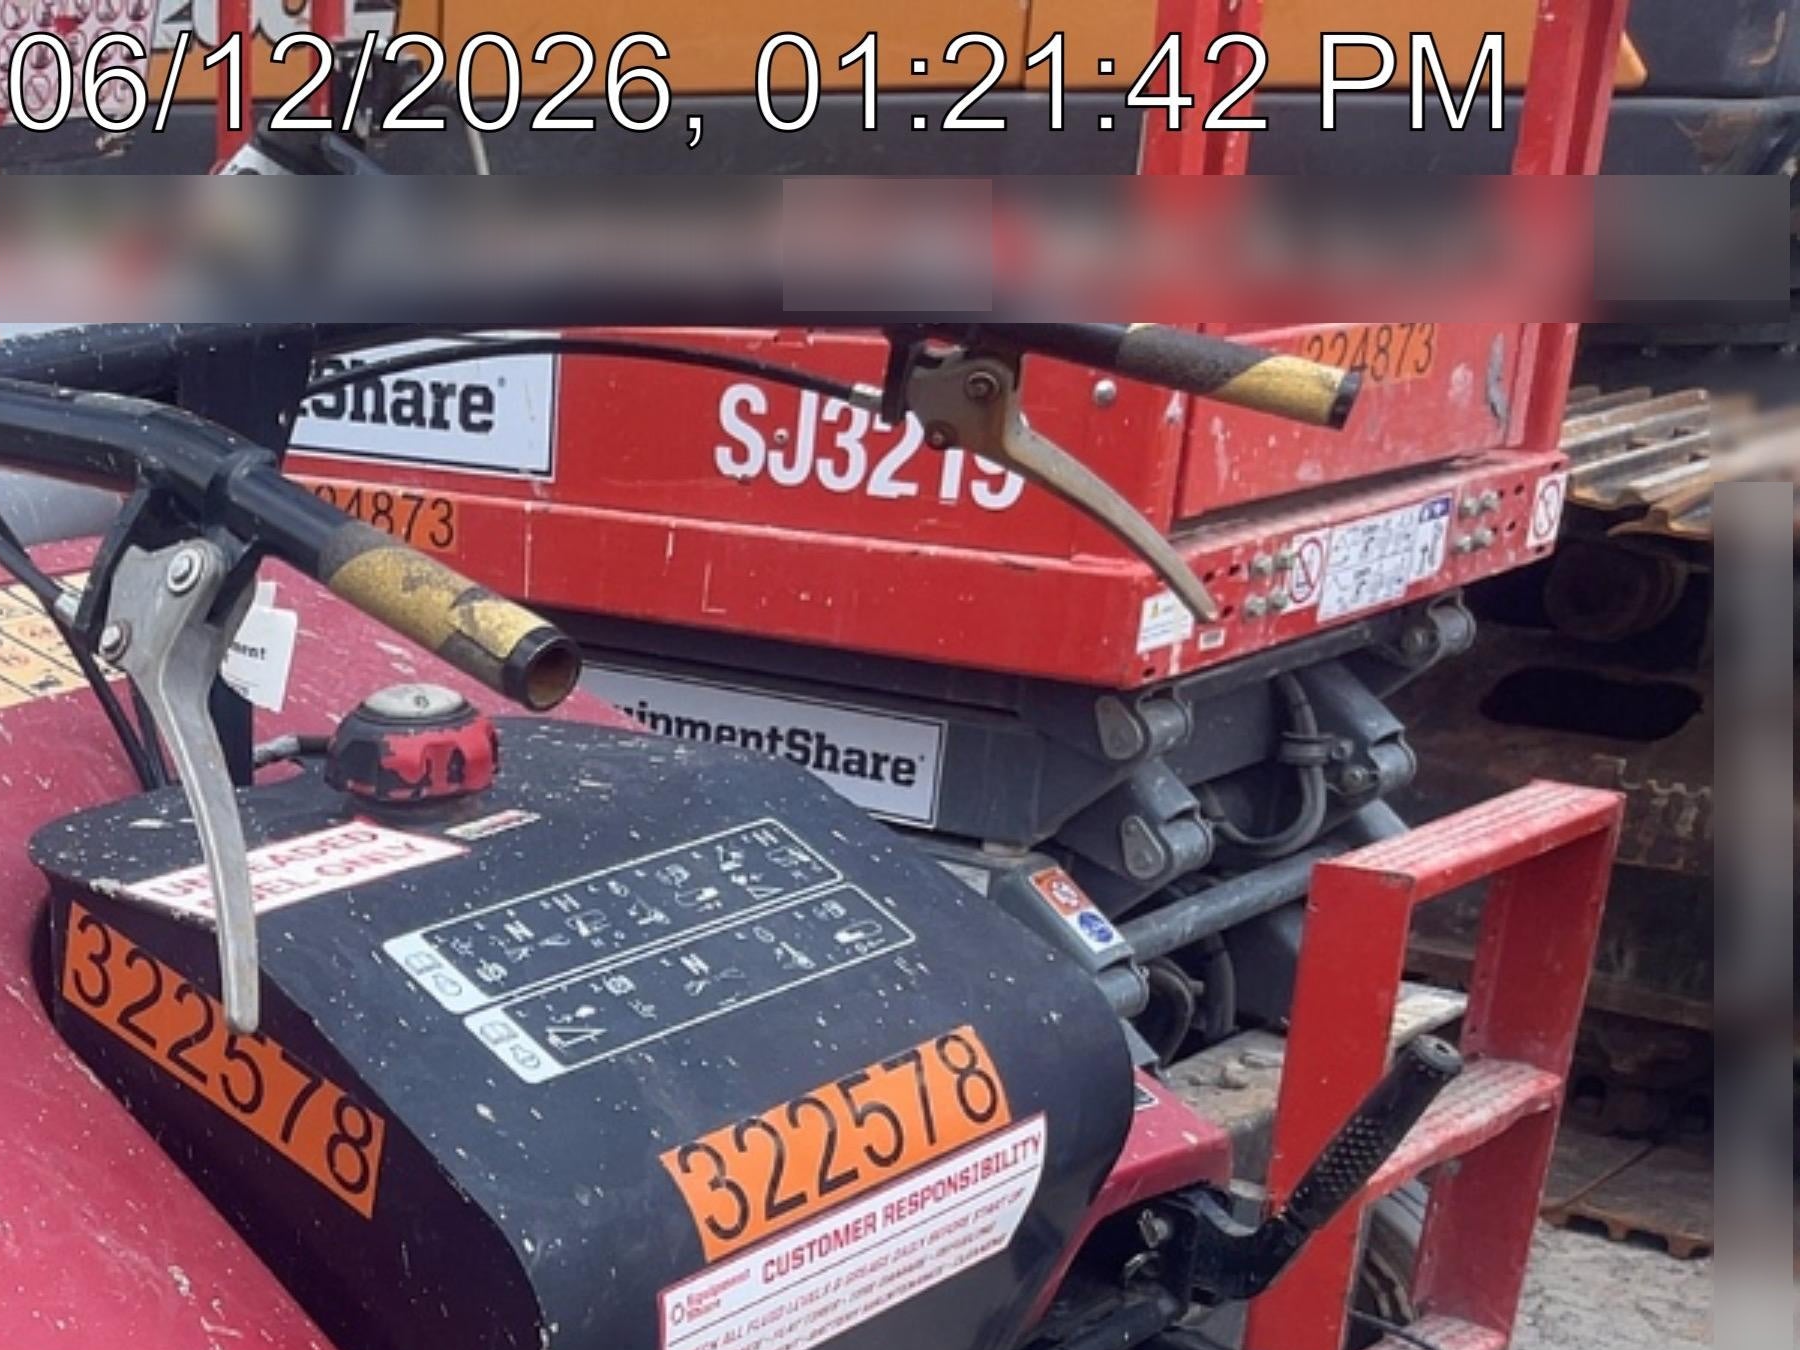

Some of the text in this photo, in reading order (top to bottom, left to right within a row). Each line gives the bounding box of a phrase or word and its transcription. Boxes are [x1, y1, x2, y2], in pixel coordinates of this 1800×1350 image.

[72, 914, 374, 1196] 322578
[677, 1033, 997, 1241] 322578
[761, 1130, 1042, 1286] CUSTOMER RESPONSIBILITY
